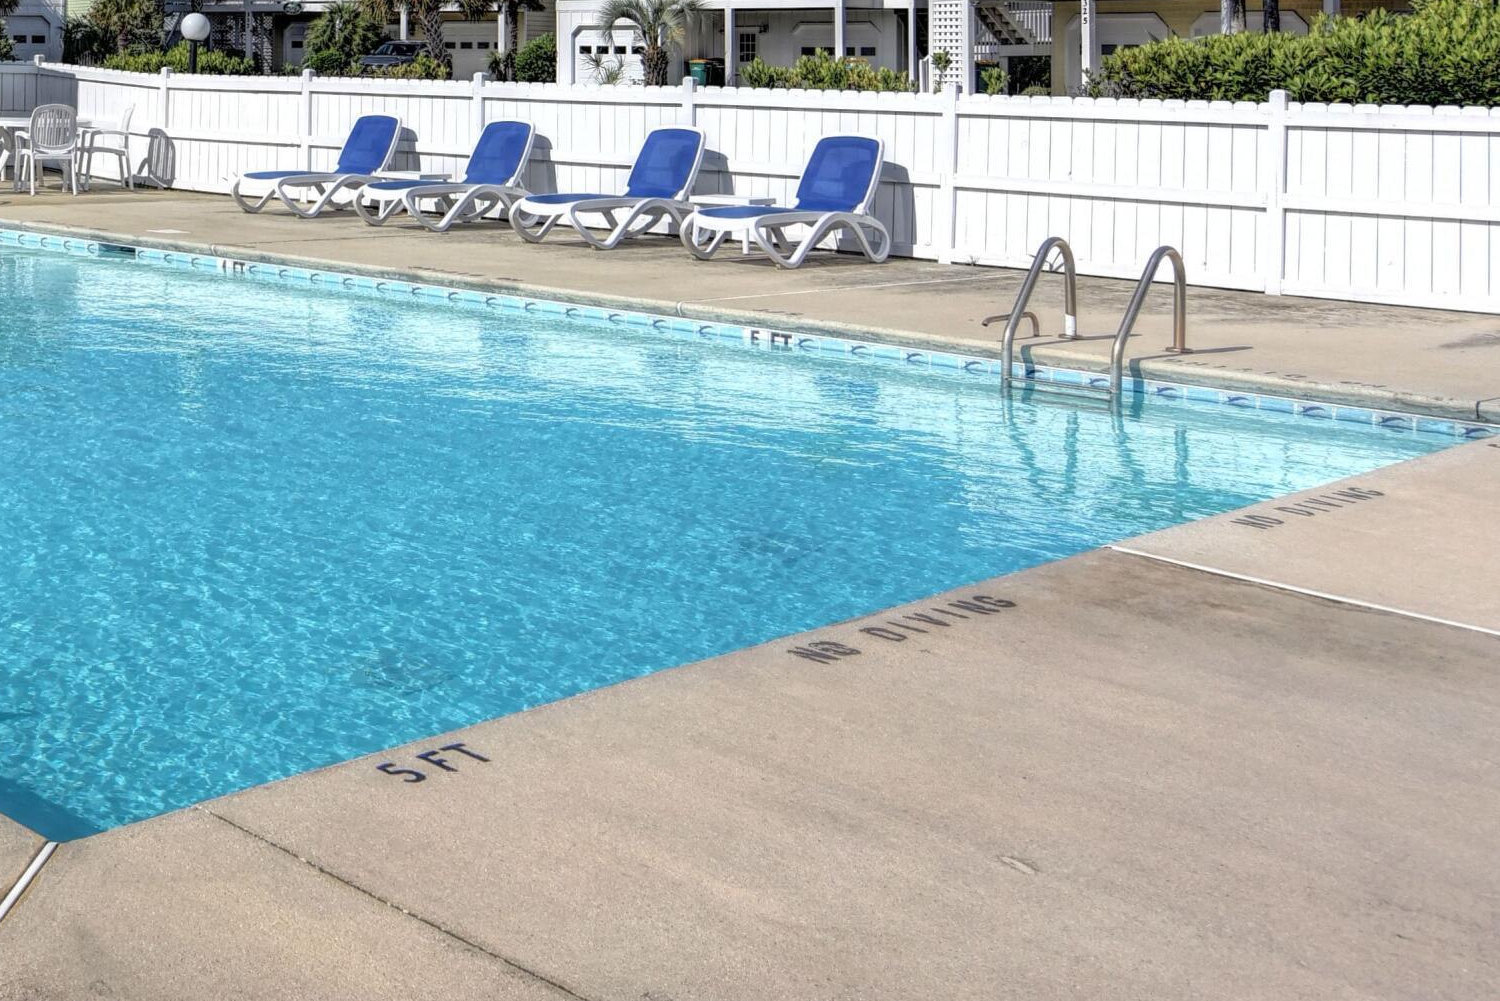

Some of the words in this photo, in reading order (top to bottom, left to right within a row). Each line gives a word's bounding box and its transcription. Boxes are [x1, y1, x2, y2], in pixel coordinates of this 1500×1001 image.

[771, 332, 792, 345] FT
[1230, 514, 1284, 529] NO
[1273, 487, 1385, 517] DIVING
[786, 640, 861, 665] NO
[858, 595, 1017, 642] DIVING
[376, 762, 427, 783] 5
[415, 742, 492, 772] FT
